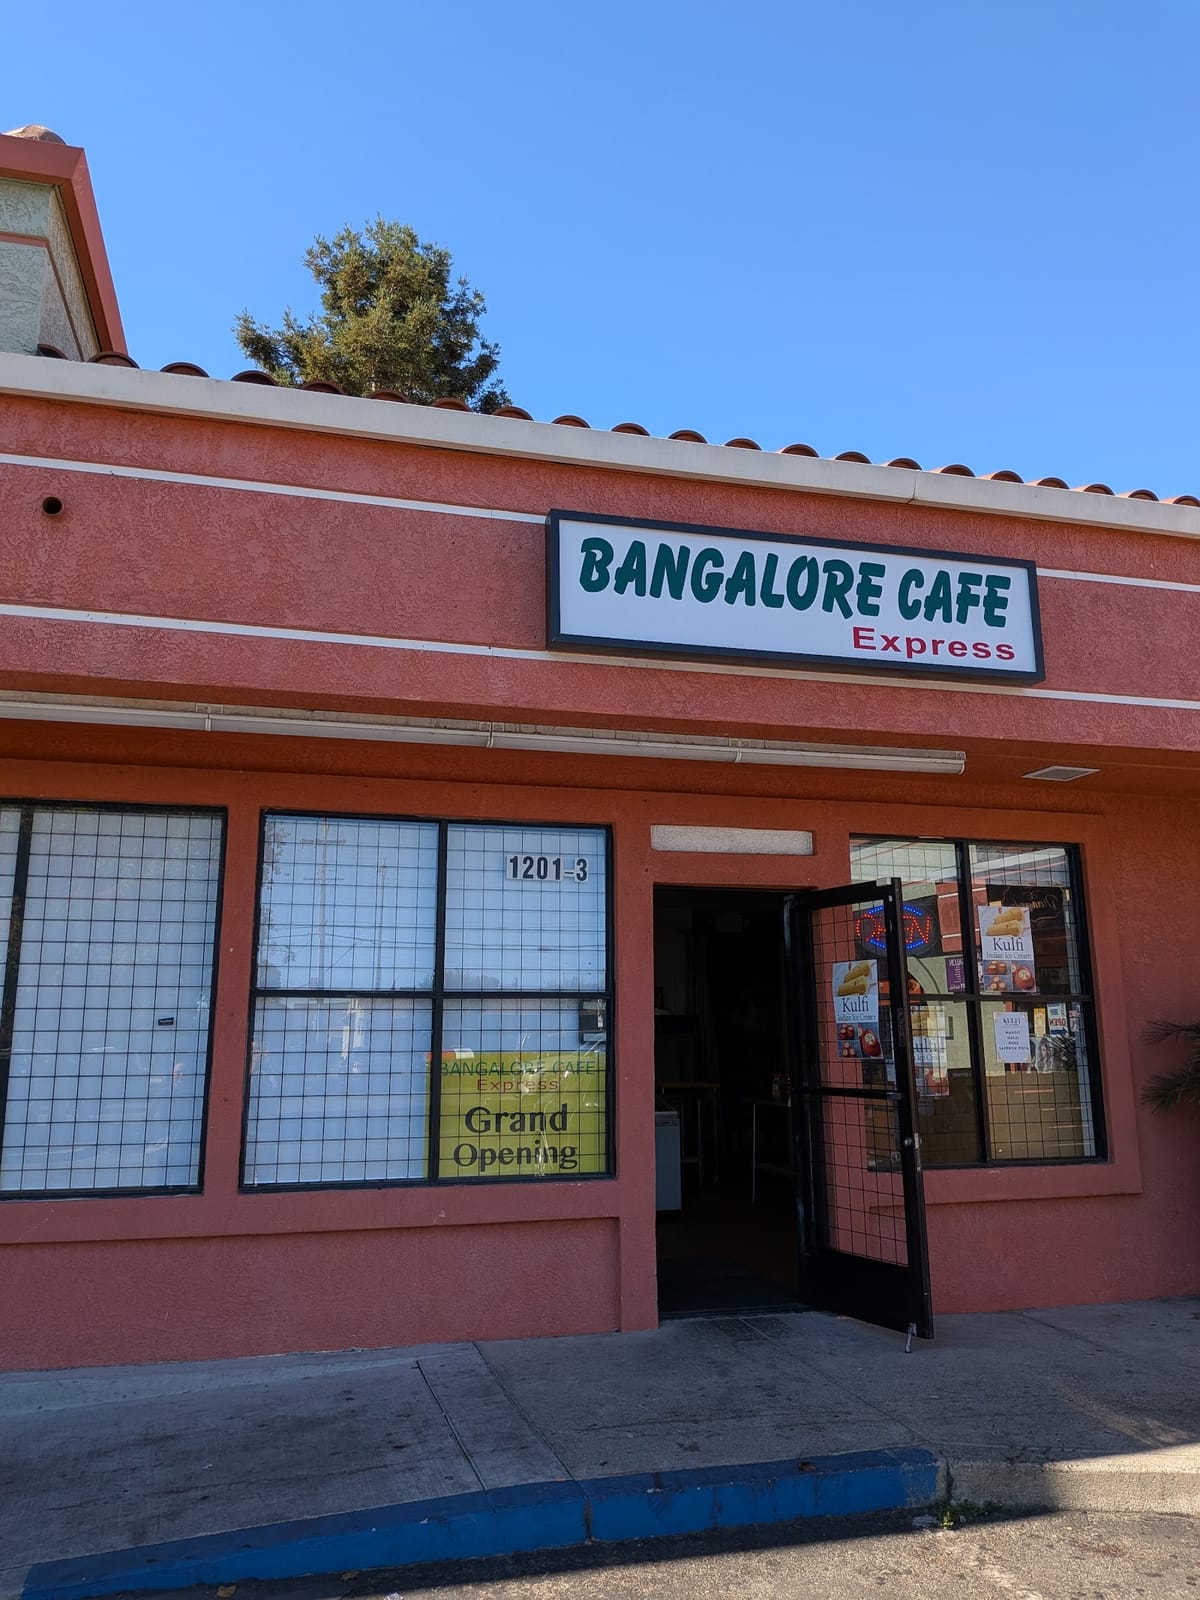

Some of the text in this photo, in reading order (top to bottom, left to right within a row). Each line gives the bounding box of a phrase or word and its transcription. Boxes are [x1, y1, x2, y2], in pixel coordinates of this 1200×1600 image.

[579, 537, 1012, 628] BANGALORE CAFE
[852, 626, 1016, 661] Express
[509, 856, 588, 881] 1201-3
[992, 937, 1024, 952] Kulfi
[841, 996, 869, 1012] Kulfi
[441, 1060, 596, 1076] BANGALORE CAFE
[476, 1078, 559, 1094] Express
[464, 1103, 568, 1133] Grand
[453, 1139, 578, 1172] Opening
